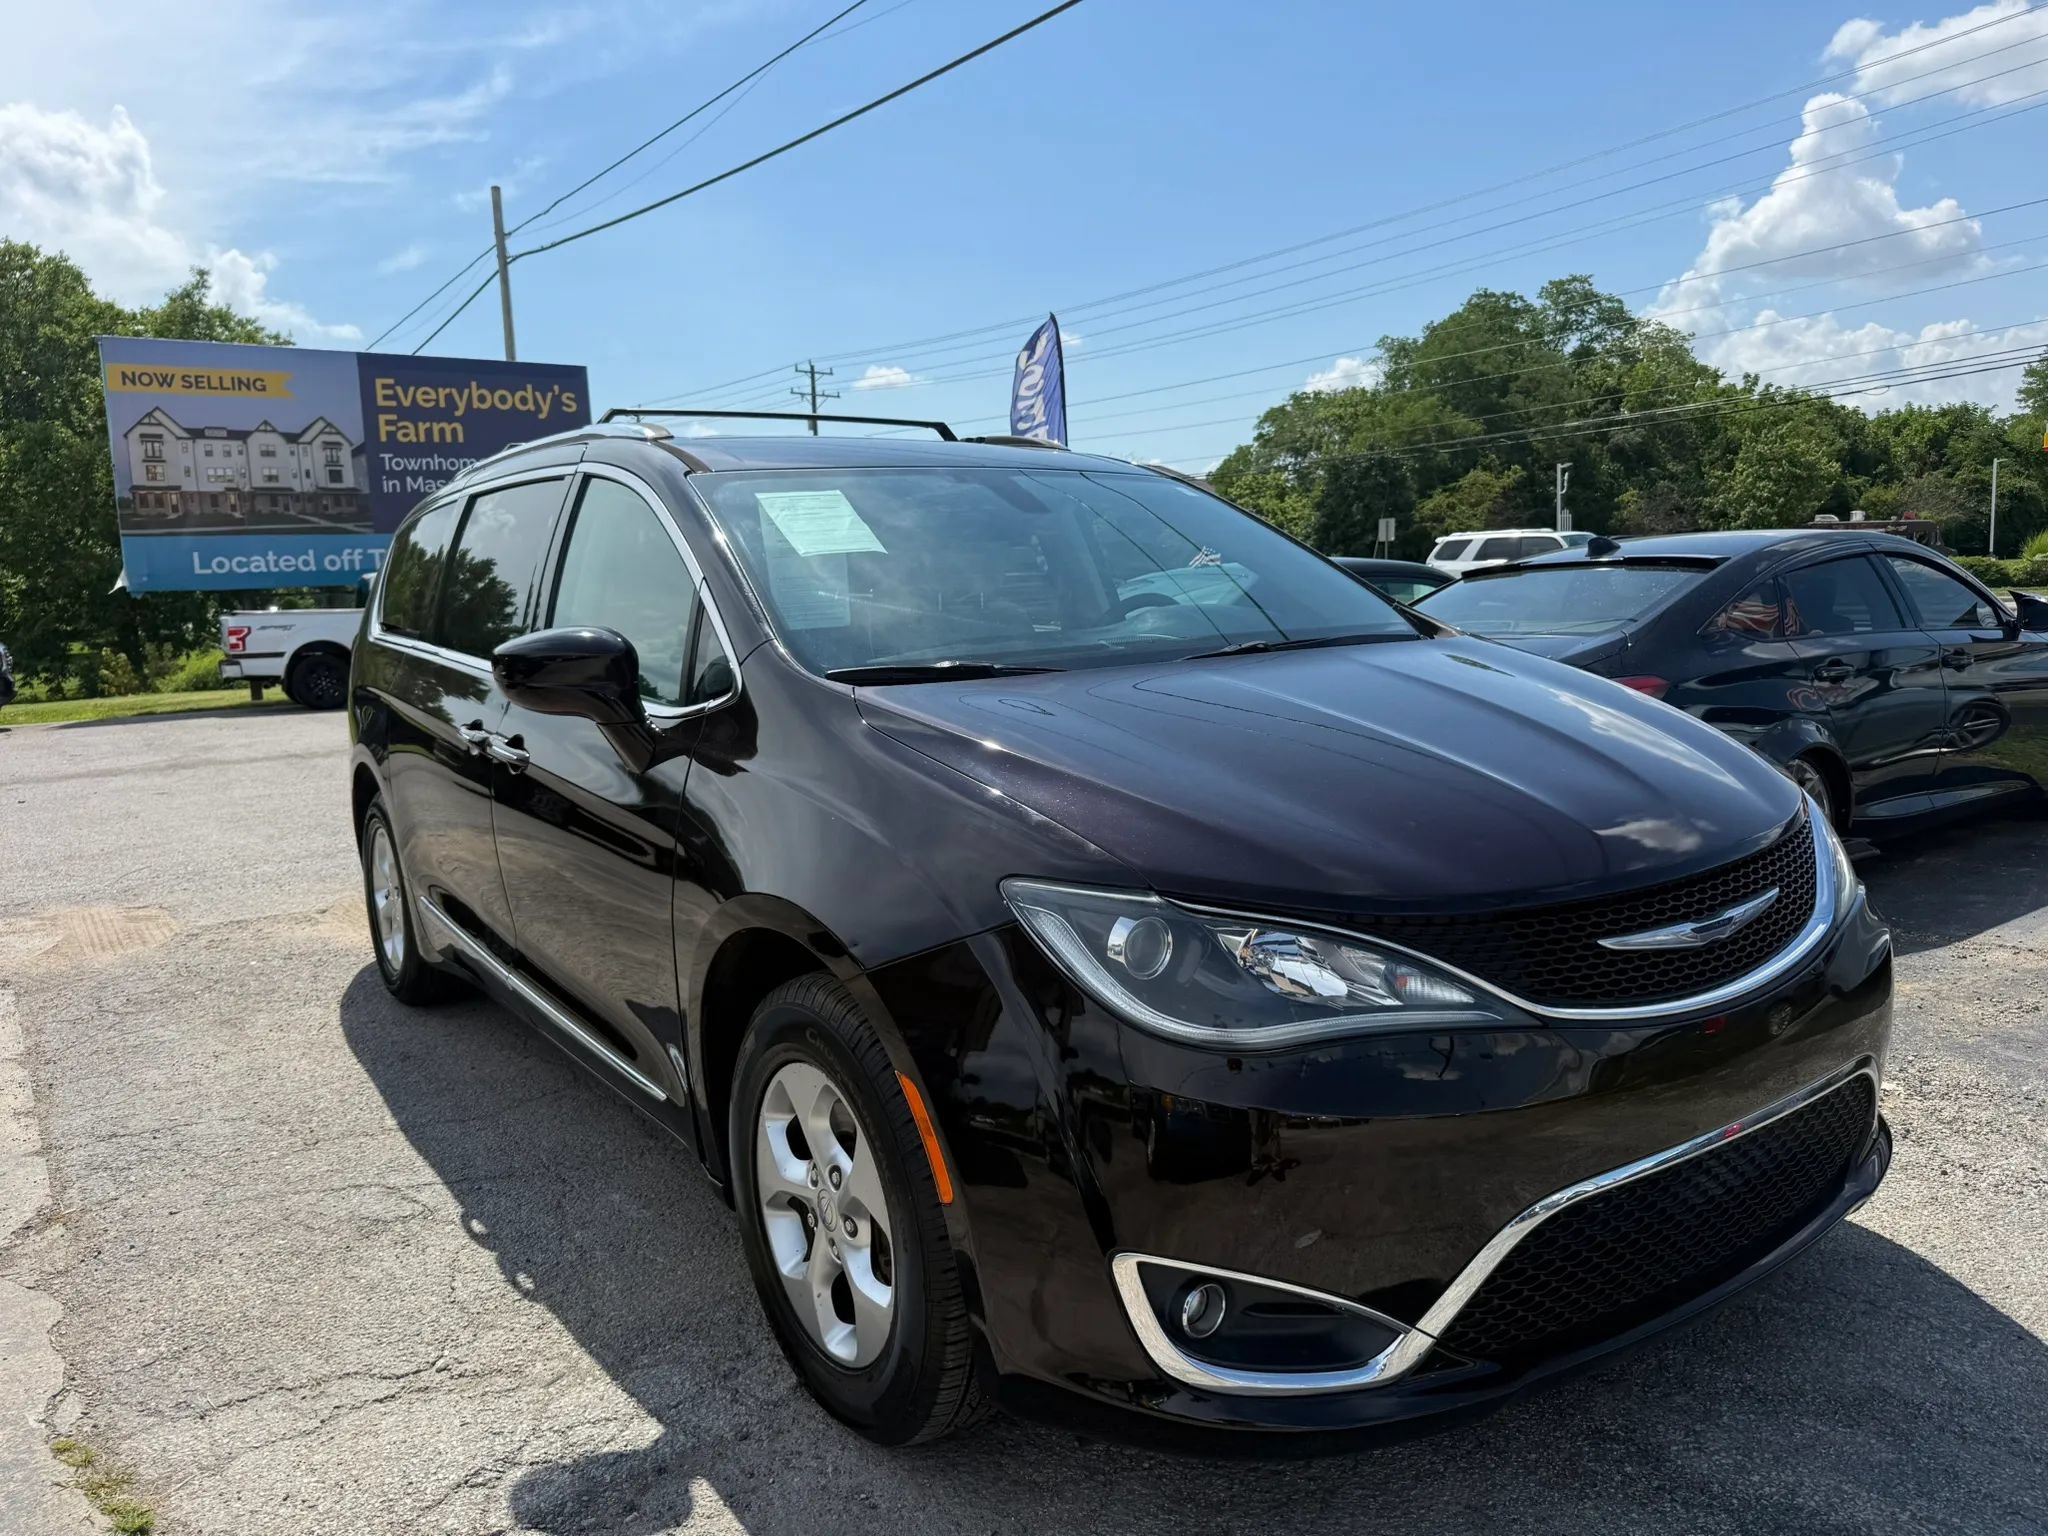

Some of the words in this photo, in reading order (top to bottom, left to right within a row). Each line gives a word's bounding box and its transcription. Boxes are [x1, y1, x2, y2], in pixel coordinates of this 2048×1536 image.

[121, 370, 176, 388] NOW
[181, 374, 267, 392] SELLING
[375, 377, 578, 420] Everybody's
[378, 413, 465, 443] Farm
[382, 476, 401, 493] in
[192, 550, 317, 575] Located
[323, 548, 363, 571] off
